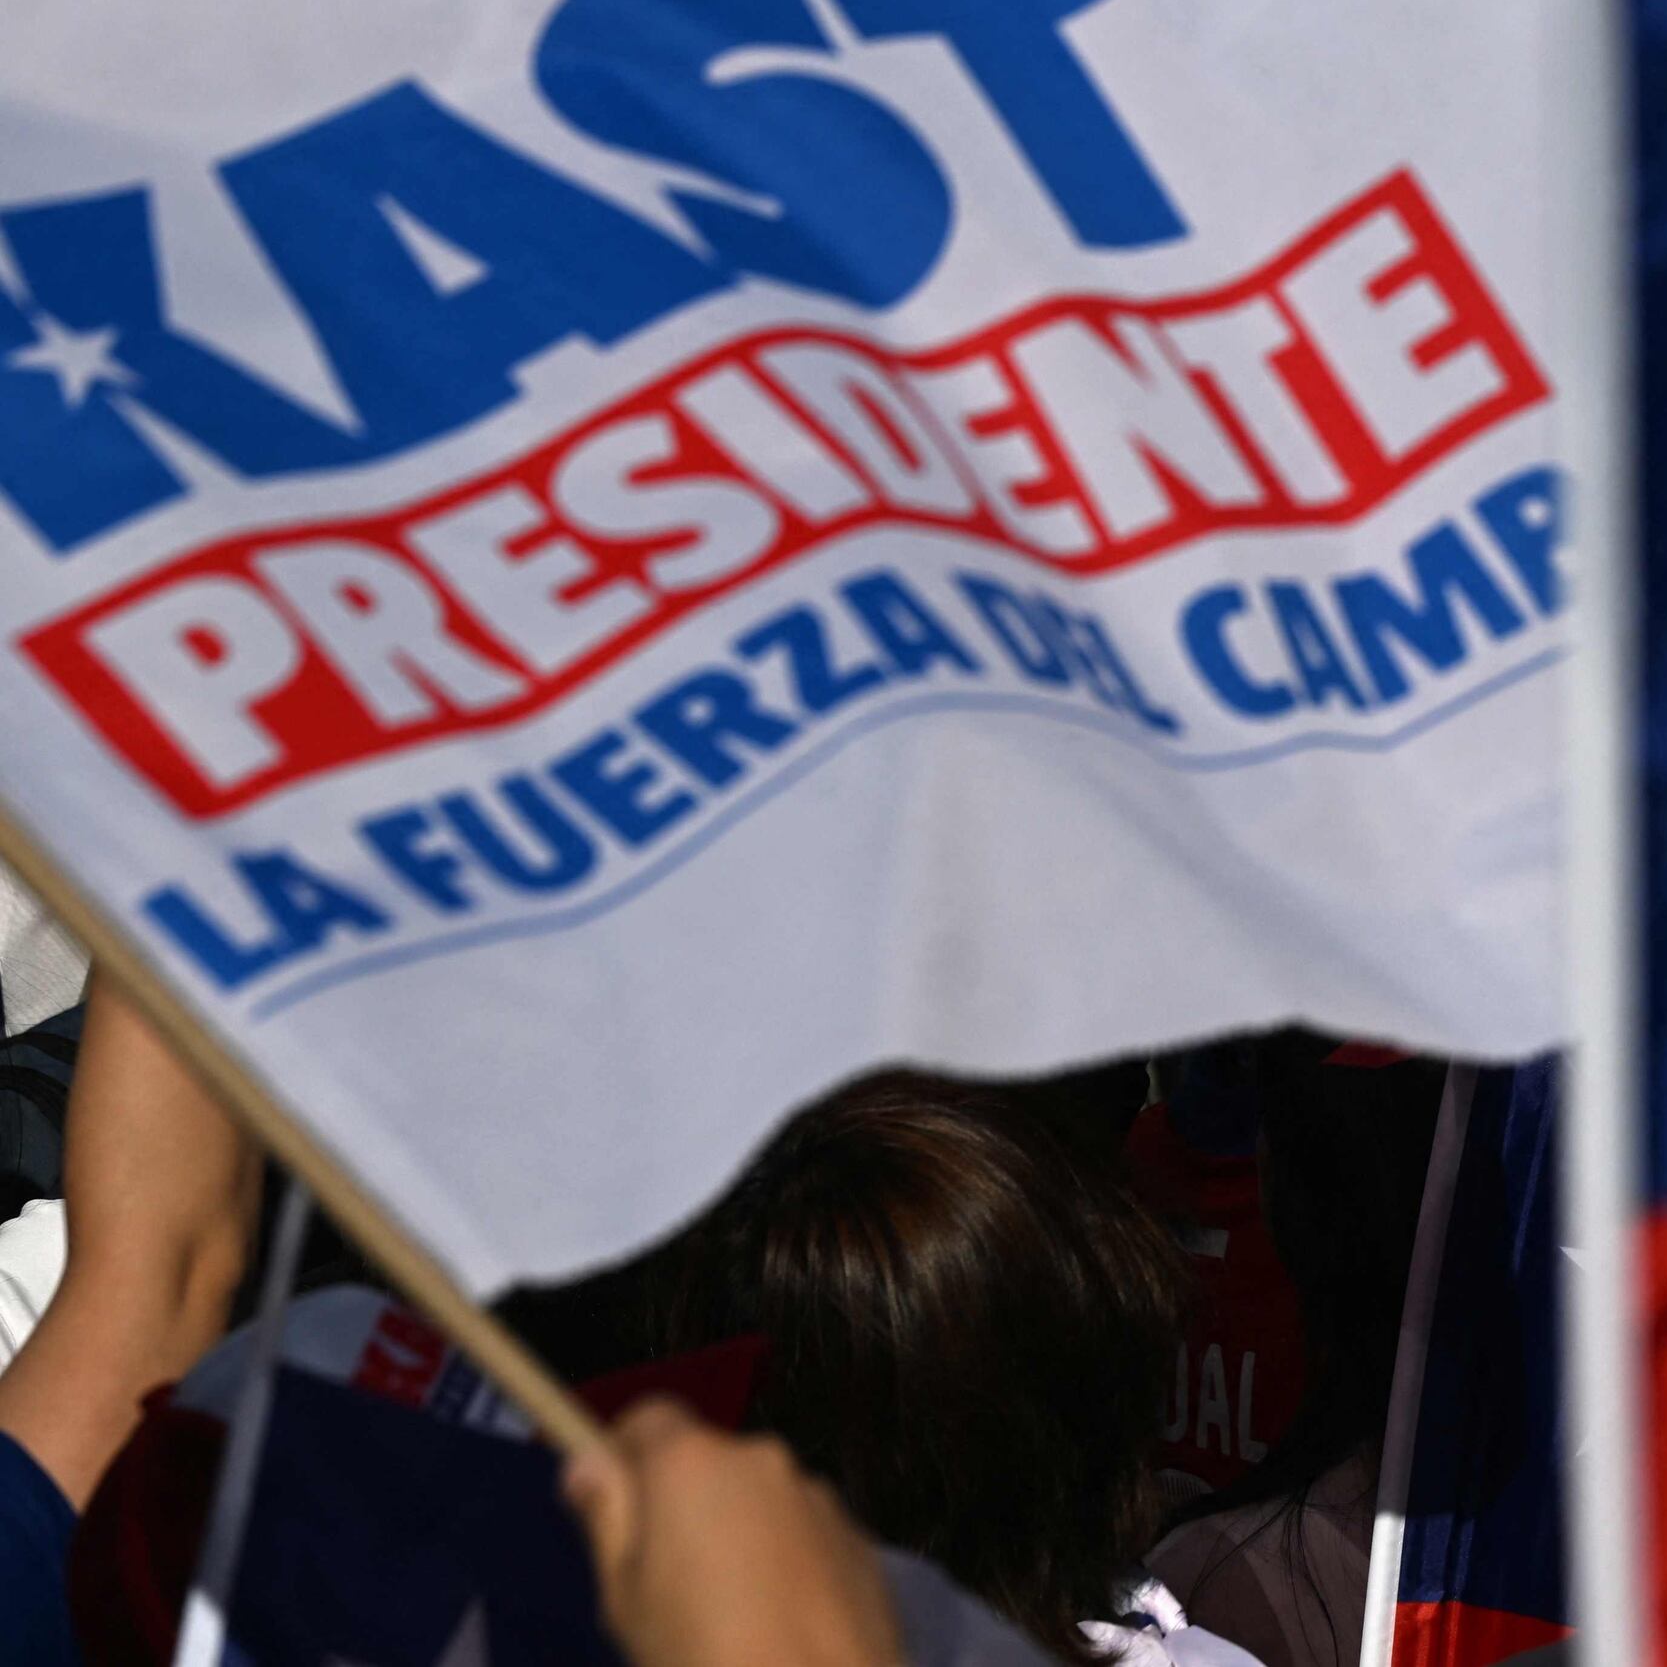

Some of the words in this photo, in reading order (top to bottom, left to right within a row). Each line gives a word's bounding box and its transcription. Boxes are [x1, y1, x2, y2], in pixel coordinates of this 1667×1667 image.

[80, 200, 1512, 796] PRESIDENTE
[135, 844, 396, 996] LA
[356, 565, 986, 917] FUERZA
[948, 569, 1186, 736] DEL
